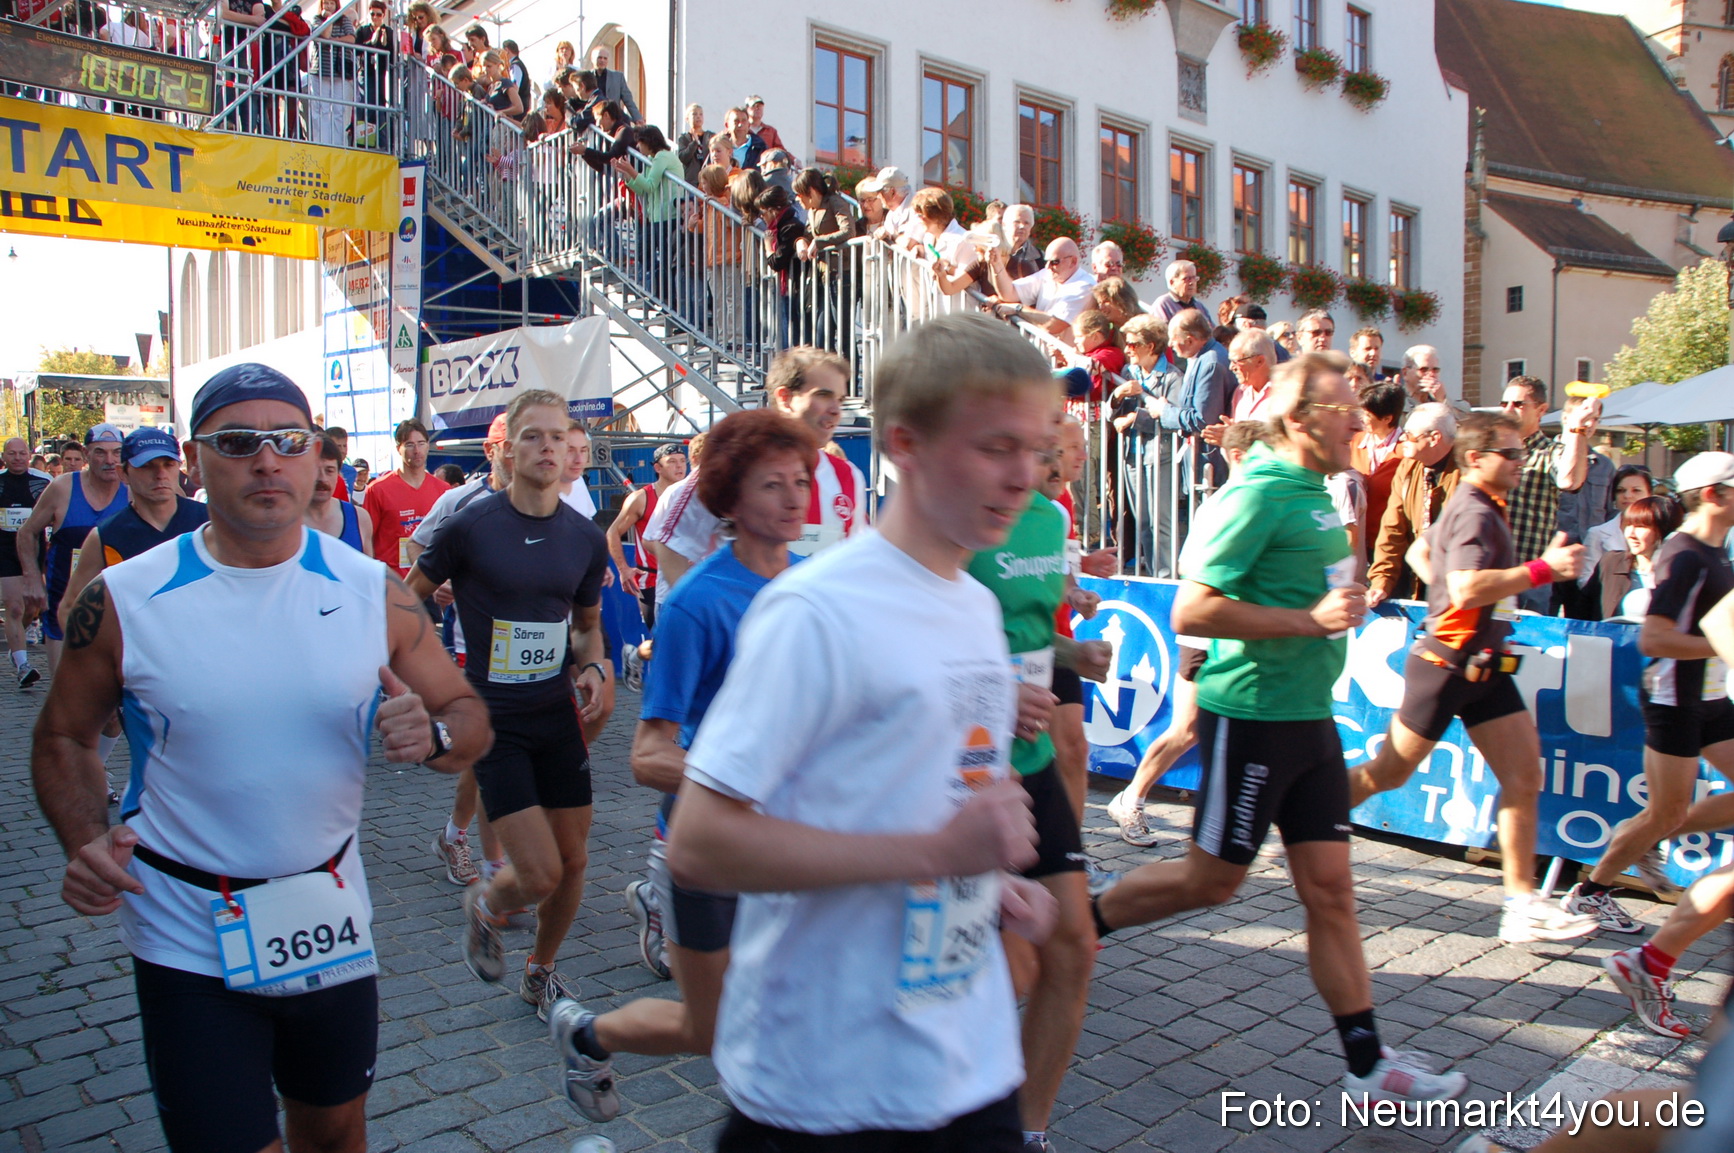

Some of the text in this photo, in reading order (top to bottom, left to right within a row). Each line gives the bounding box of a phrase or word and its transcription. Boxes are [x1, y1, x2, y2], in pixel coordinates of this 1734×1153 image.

[36, 32, 98, 52] Elektronische
[236, 180, 366, 206] Neumarkter Stadtlauf
[430, 346, 521, 398] BOCK
[513, 627, 545, 640] Sören
[520, 647, 556, 666] 984
[266, 915, 360, 968] 3694
